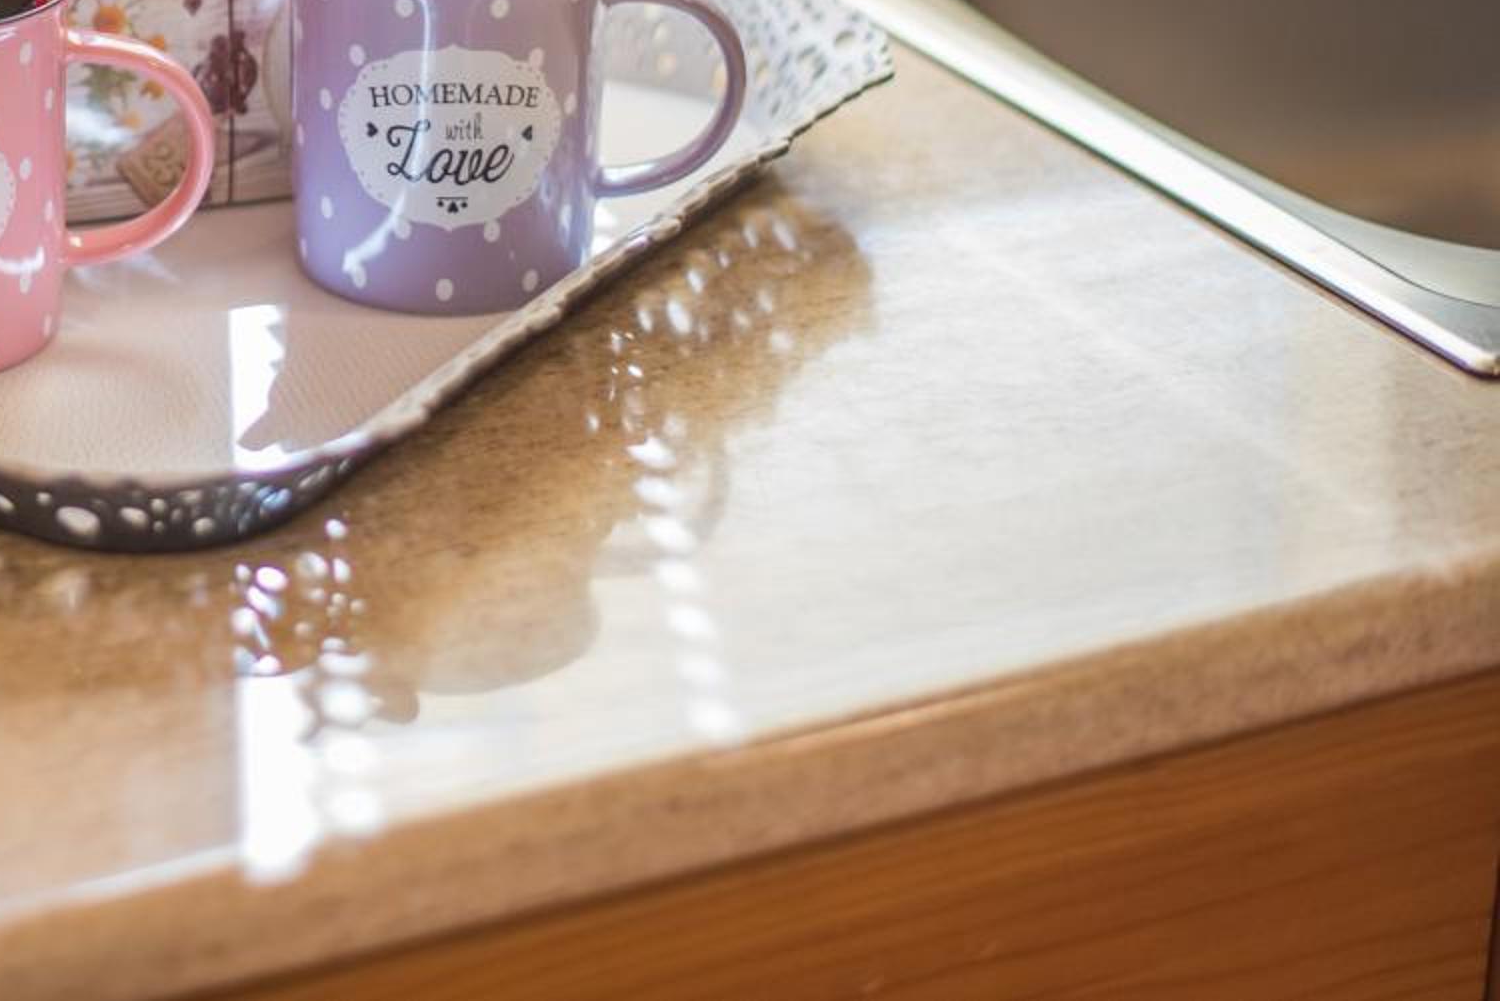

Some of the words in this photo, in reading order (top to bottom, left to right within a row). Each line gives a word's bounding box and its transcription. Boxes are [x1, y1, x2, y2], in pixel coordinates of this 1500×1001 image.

[369, 83, 539, 108] HOMEMADE
[445, 112, 484, 141] with
[387, 119, 514, 185] Love
